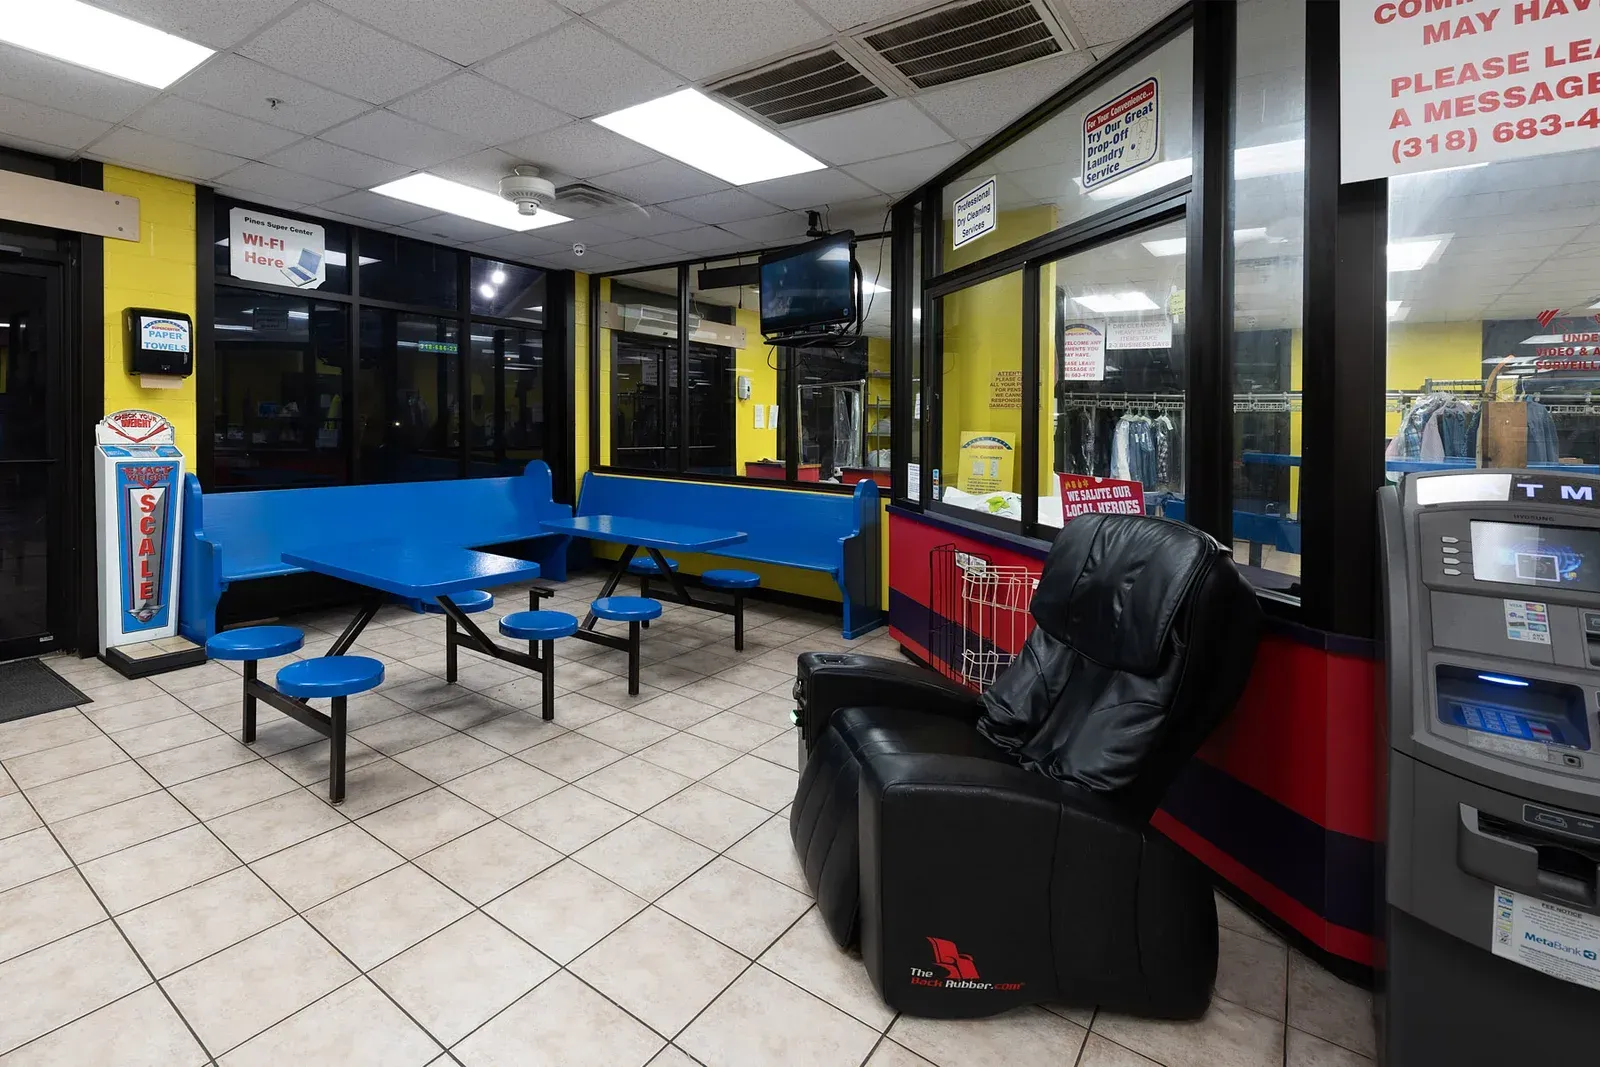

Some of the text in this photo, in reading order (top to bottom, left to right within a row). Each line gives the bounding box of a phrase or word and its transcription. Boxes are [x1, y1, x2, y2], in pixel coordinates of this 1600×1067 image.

[1423, 0, 1600, 45] MAY HAV
[1391, 38, 1600, 98] PLEASE LE
[1087, 90, 1153, 130] For Your Convenience...
[1389, 71, 1600, 130] A MESSAGE
[1088, 101, 1153, 144] Try Our Great
[1088, 127, 1129, 158] Drop-Off
[1392, 107, 1600, 164] (318) 683-4
[1087, 146, 1124, 171] Laundry
[1086, 162, 1119, 184] Service
[957, 187, 991, 213] Professional
[957, 203, 991, 227] Dry Cleaning
[244, 216, 313, 236] Pines Super Center
[962, 221, 985, 237] Services
[243, 232, 284, 251] WI-FI
[244, 251, 284, 268] Here
[149, 331, 182, 340] PAPER
[144, 342, 187, 351] TOWELS
[1536, 347, 1574, 356] VIDEO
[1579, 347, 1588, 356] &
[1536, 361, 1600, 370] SURVEILL
[113, 413, 157, 422] CHECK YOUR
[121, 418, 151, 428] WEIGHT
[1066, 485, 1132, 501] WE SALUTE OUR
[1065, 499, 1141, 517] LOCAL HEROES
[138, 494, 156, 600] SCALE
[1541, 902, 1583, 919] FEE NOTICE
[1524, 932, 1582, 956] MetaBank
[910, 967, 933, 978] The
[911, 977, 942, 988] Back
